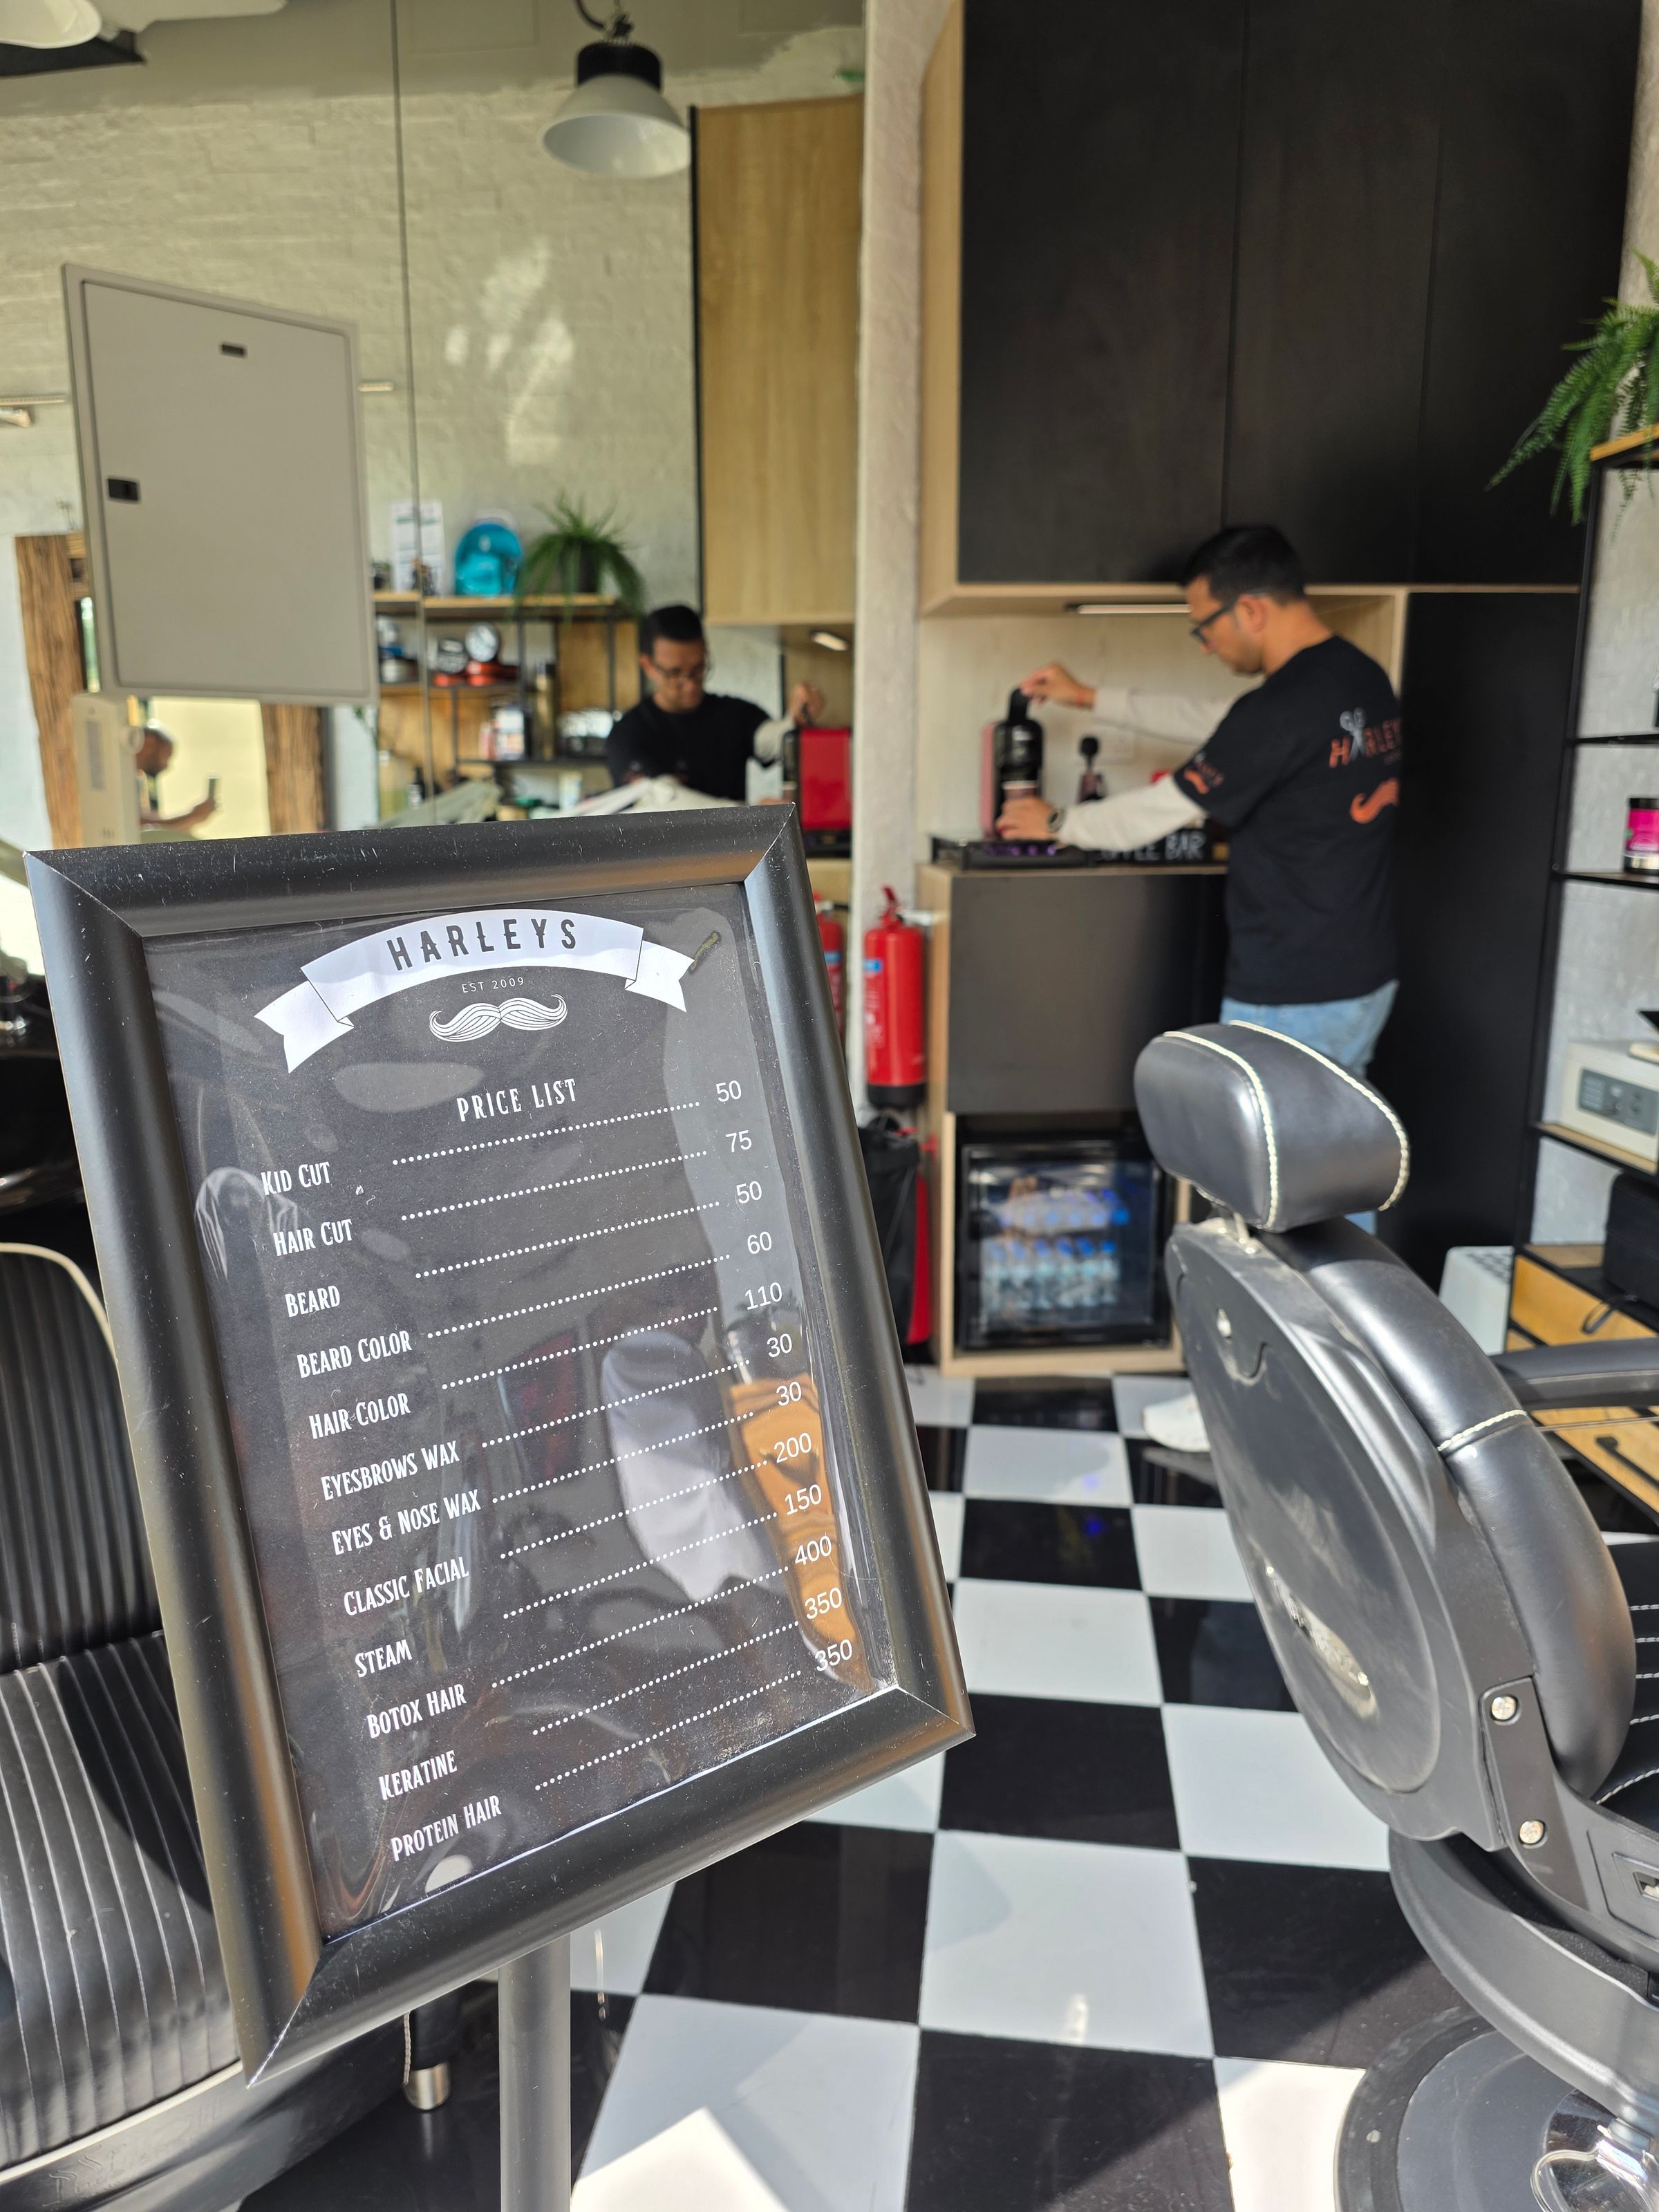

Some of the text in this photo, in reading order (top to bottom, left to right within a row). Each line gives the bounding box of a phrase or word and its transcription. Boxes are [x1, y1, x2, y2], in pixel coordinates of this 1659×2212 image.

[386, 919, 577, 971] HARLEYS
[461, 977, 525, 993] EST 2009
[261, 1080, 741, 1195] KID CUT 50
[457, 1078, 577, 1121] PRICE LIST
[273, 1130, 751, 1256] HAIR CUT 75
[285, 1181, 762, 1317] BEARD 50
[297, 1232, 771, 1378] BEARD COLOR 60
[309, 1282, 782, 1439] HAIR COLOR 110
[321, 1334, 791, 1500] EYESBROWS WAX 30
[332, 1382, 801, 1555] EYES & NOSE WAX 30
[344, 1433, 812, 1615] CLASSIC FACIAL 200
[355, 1485, 821, 1678] STEAM 150
[367, 1535, 832, 1738] BOTOX HAIR 400
[379, 1588, 841, 1800] KERATINE 350
[391, 1639, 853, 1861] PROTEIN HAIR 350
